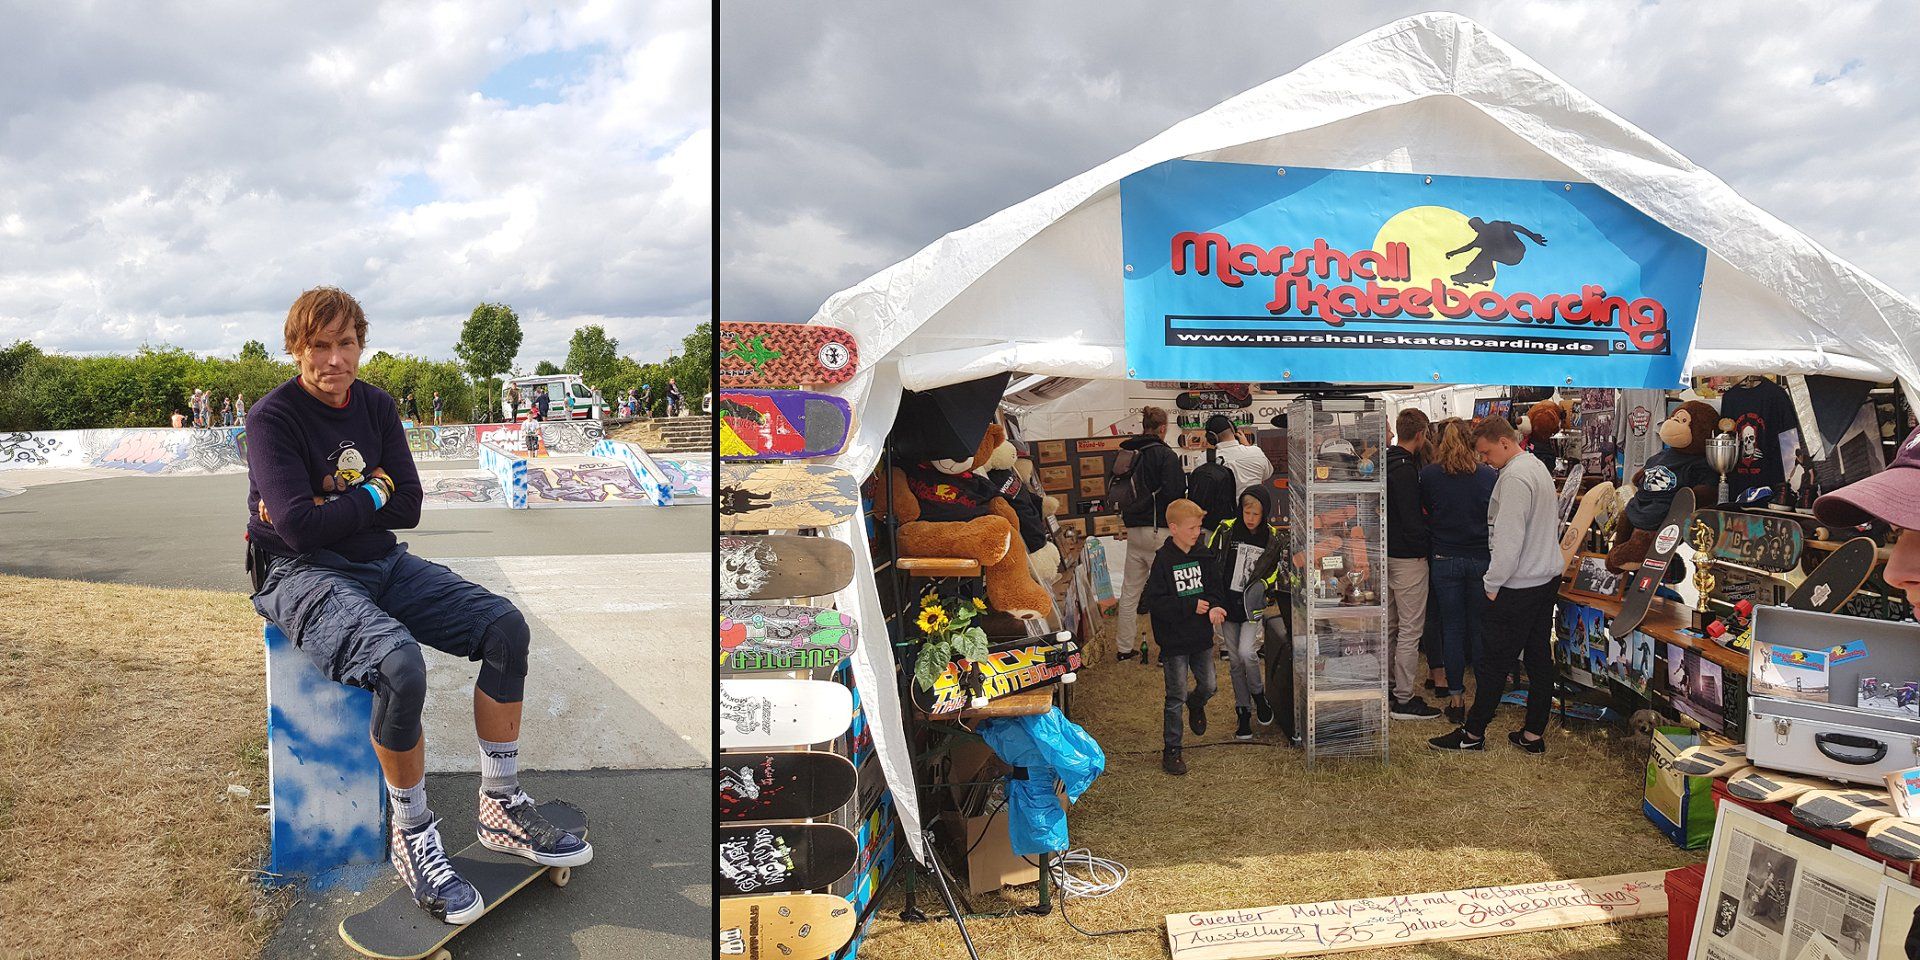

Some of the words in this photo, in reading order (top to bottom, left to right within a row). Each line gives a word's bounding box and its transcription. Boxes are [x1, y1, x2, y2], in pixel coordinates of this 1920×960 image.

[1171, 231, 1410, 287] Marshall
[1266, 272, 1668, 352] Skateboarding
[1177, 332, 1595, 352] www.marshall-skateboarding.de
[1173, 566, 1202, 581] RUN
[1175, 577, 1204, 592] DJK
